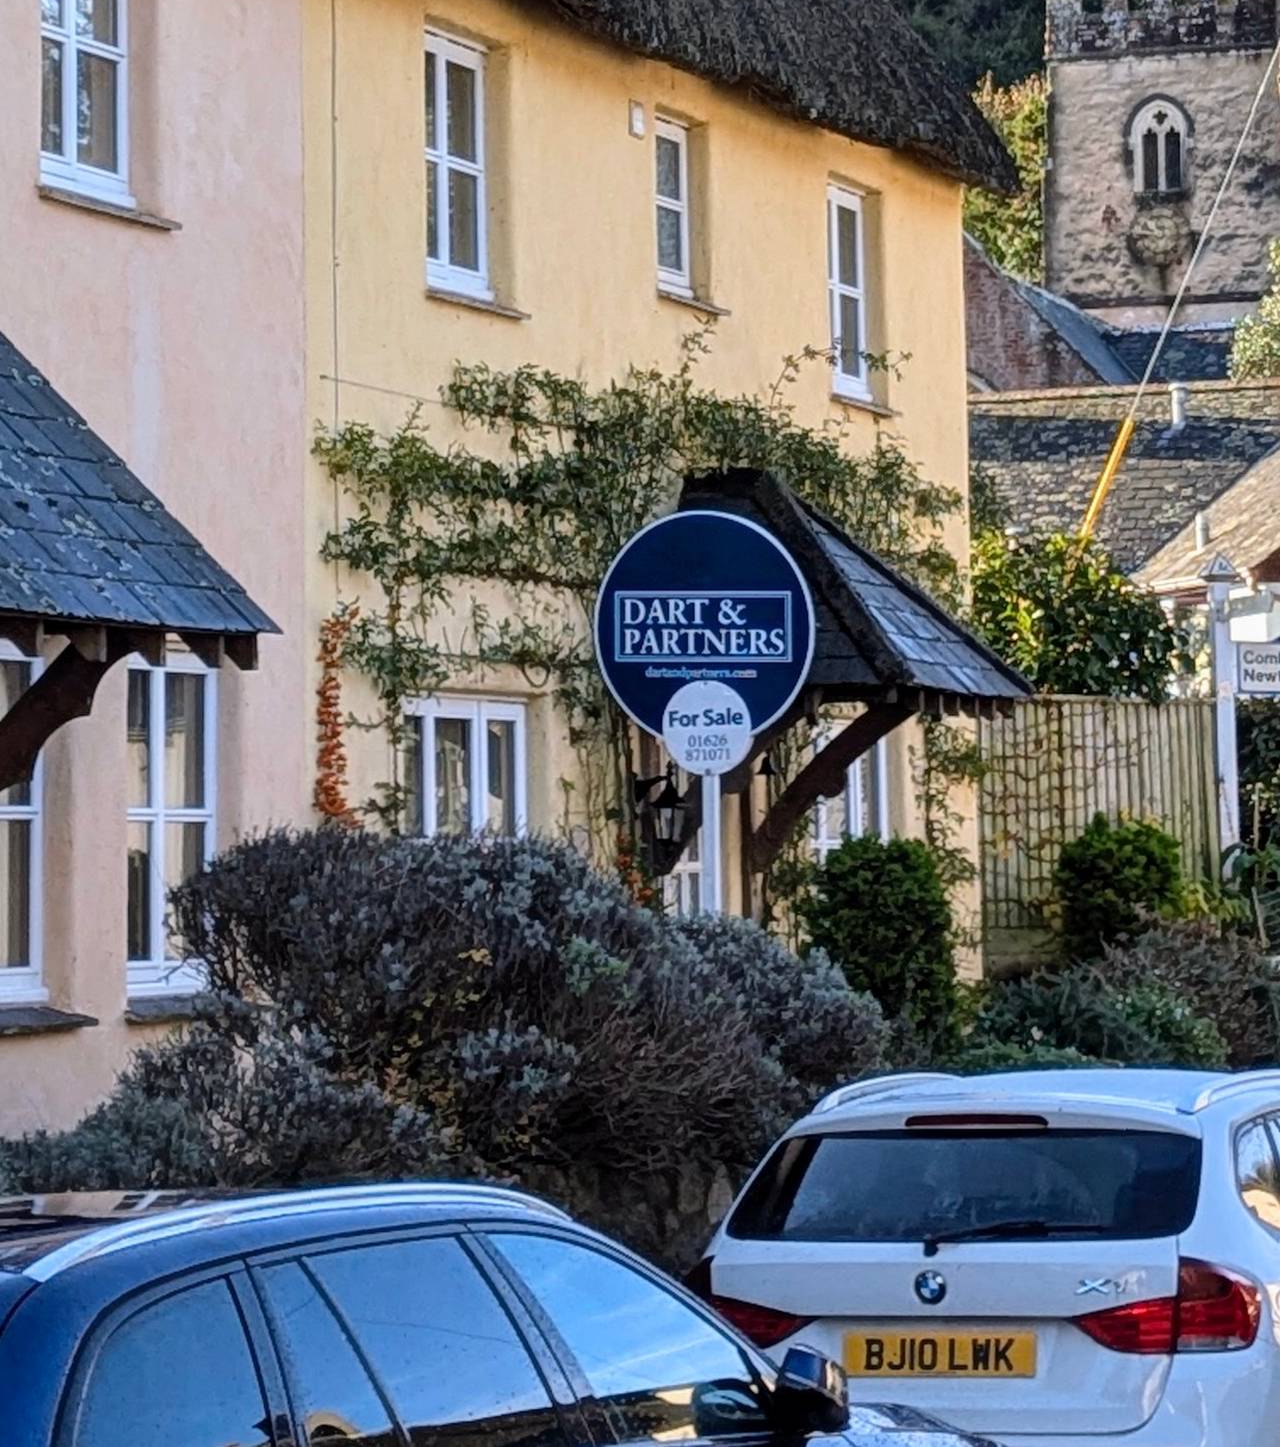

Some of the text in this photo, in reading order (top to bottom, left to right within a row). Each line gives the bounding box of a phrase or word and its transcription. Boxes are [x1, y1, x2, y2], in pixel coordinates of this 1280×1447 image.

[624, 599, 746, 625] DART &
[624, 629, 784, 655] PARTNERS
[669, 707, 743, 727] For Sale
[688, 734, 727, 747] 01626
[685, 748, 730, 761] 871071
[865, 1338, 1015, 1371] BJ10 LWK
